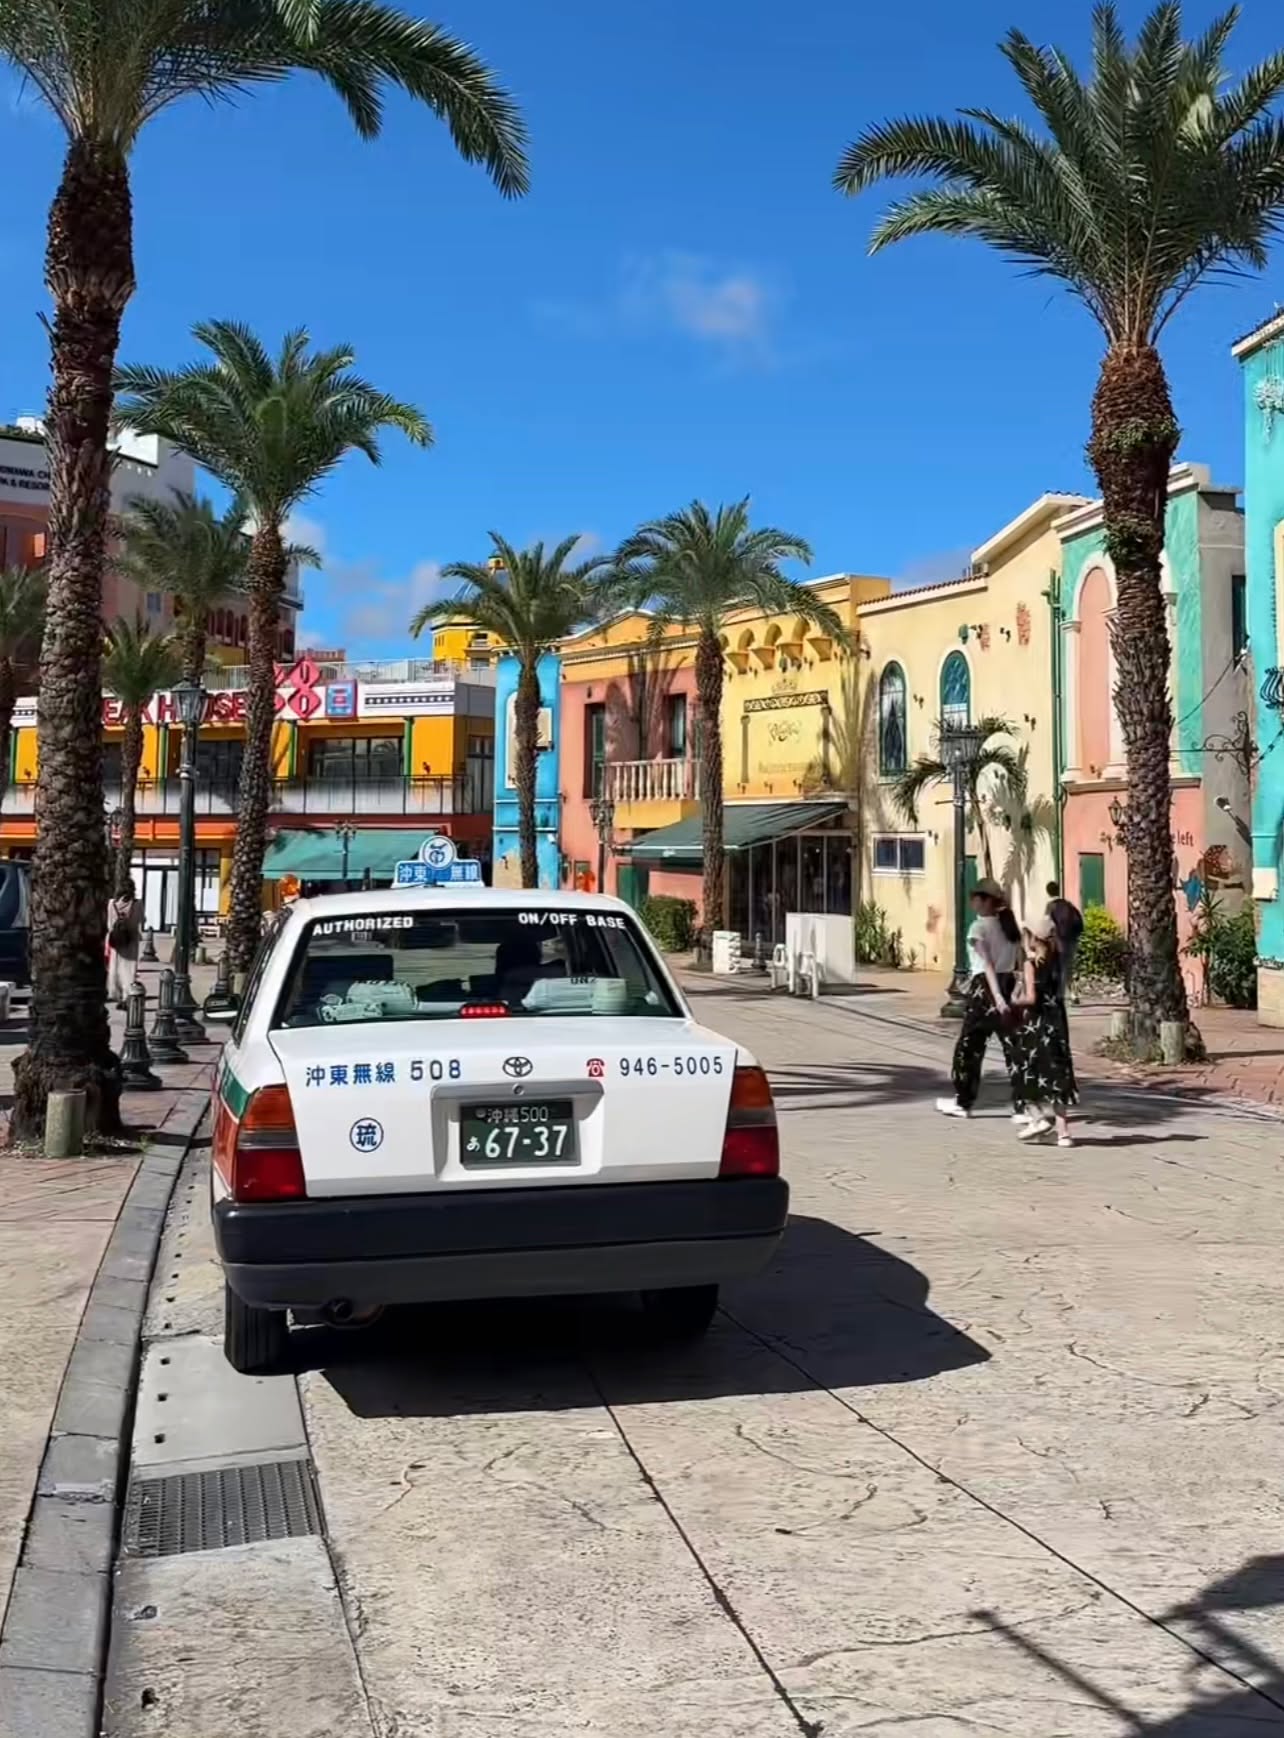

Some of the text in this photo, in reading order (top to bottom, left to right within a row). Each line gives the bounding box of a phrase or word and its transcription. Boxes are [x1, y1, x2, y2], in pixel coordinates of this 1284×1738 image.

[312, 916, 414, 936] AUTHORIZED
[518, 912, 626, 930] ON/OFF BASE
[305, 1058, 461, 1088] 沖東無線 508
[619, 1055, 723, 1077] 946-5005
[466, 1124, 568, 1158] あ 67-37
